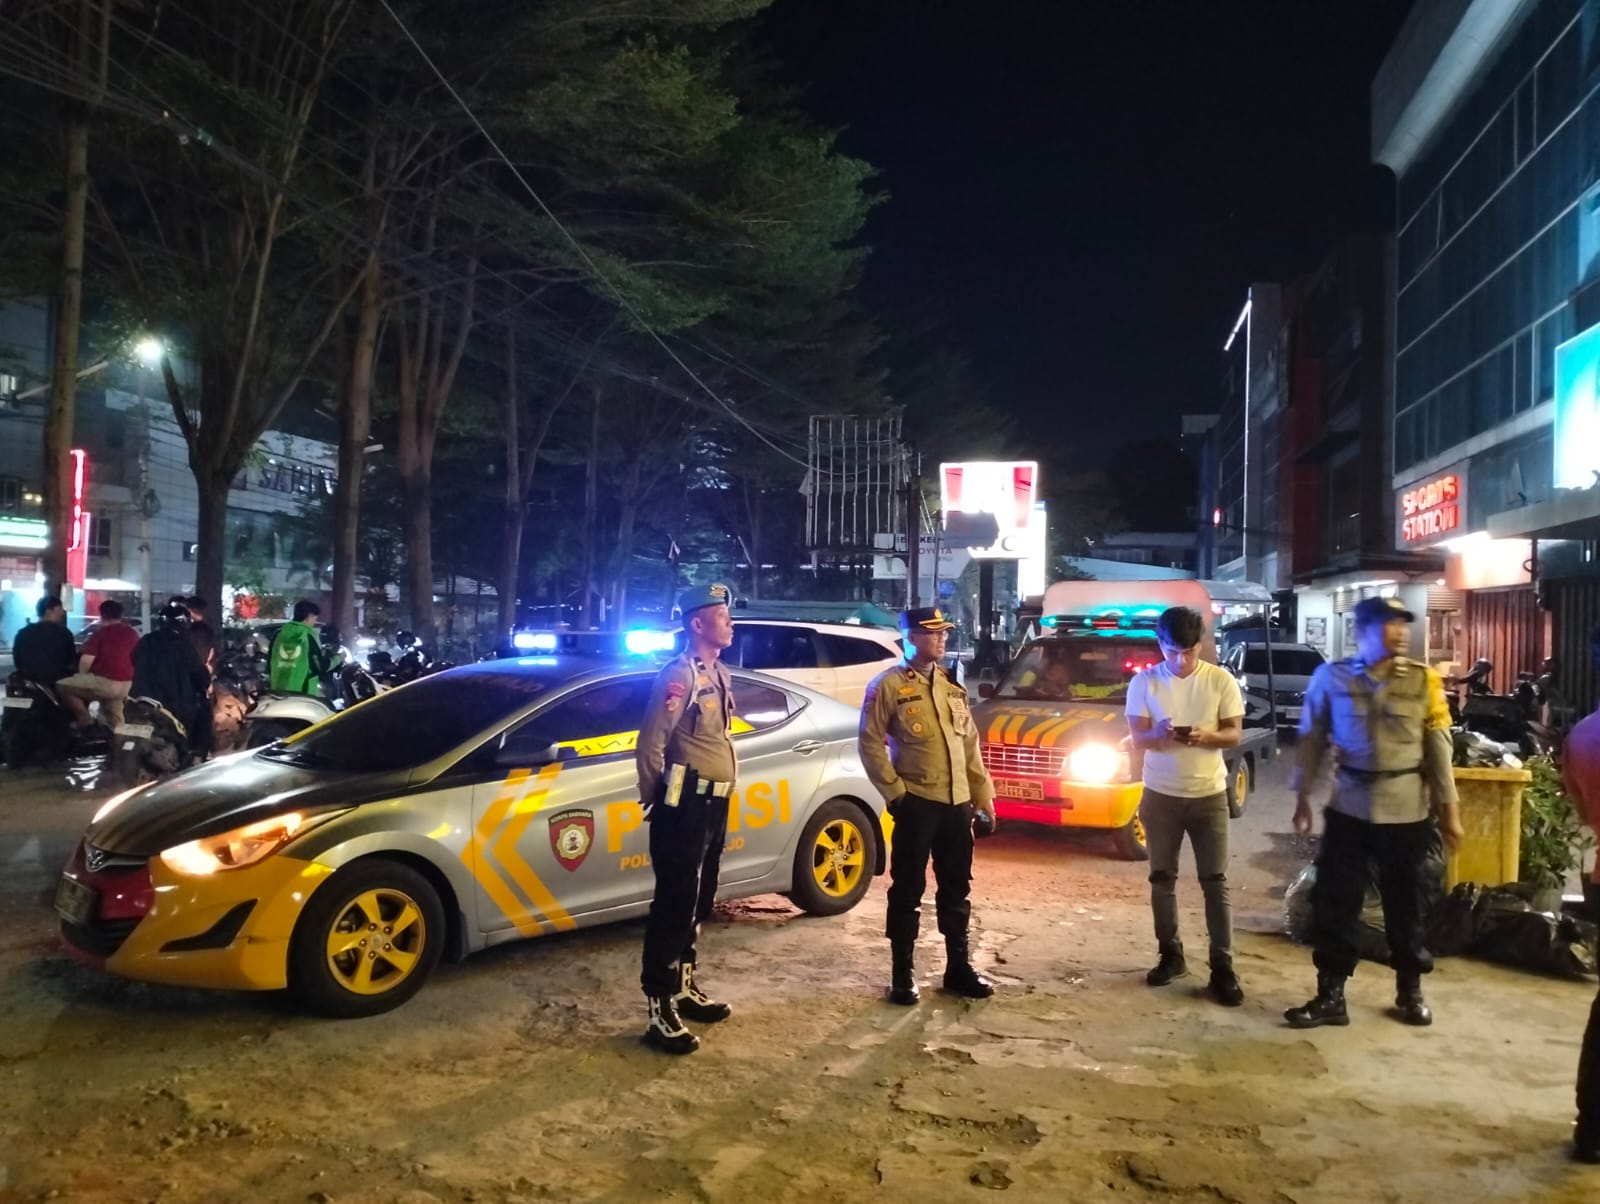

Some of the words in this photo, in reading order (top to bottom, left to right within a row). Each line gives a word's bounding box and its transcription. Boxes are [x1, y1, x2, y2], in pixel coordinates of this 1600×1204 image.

[1403, 476, 1457, 516] SPORTS
[1403, 505, 1458, 541] STATION
[606, 779, 791, 853] PISI
